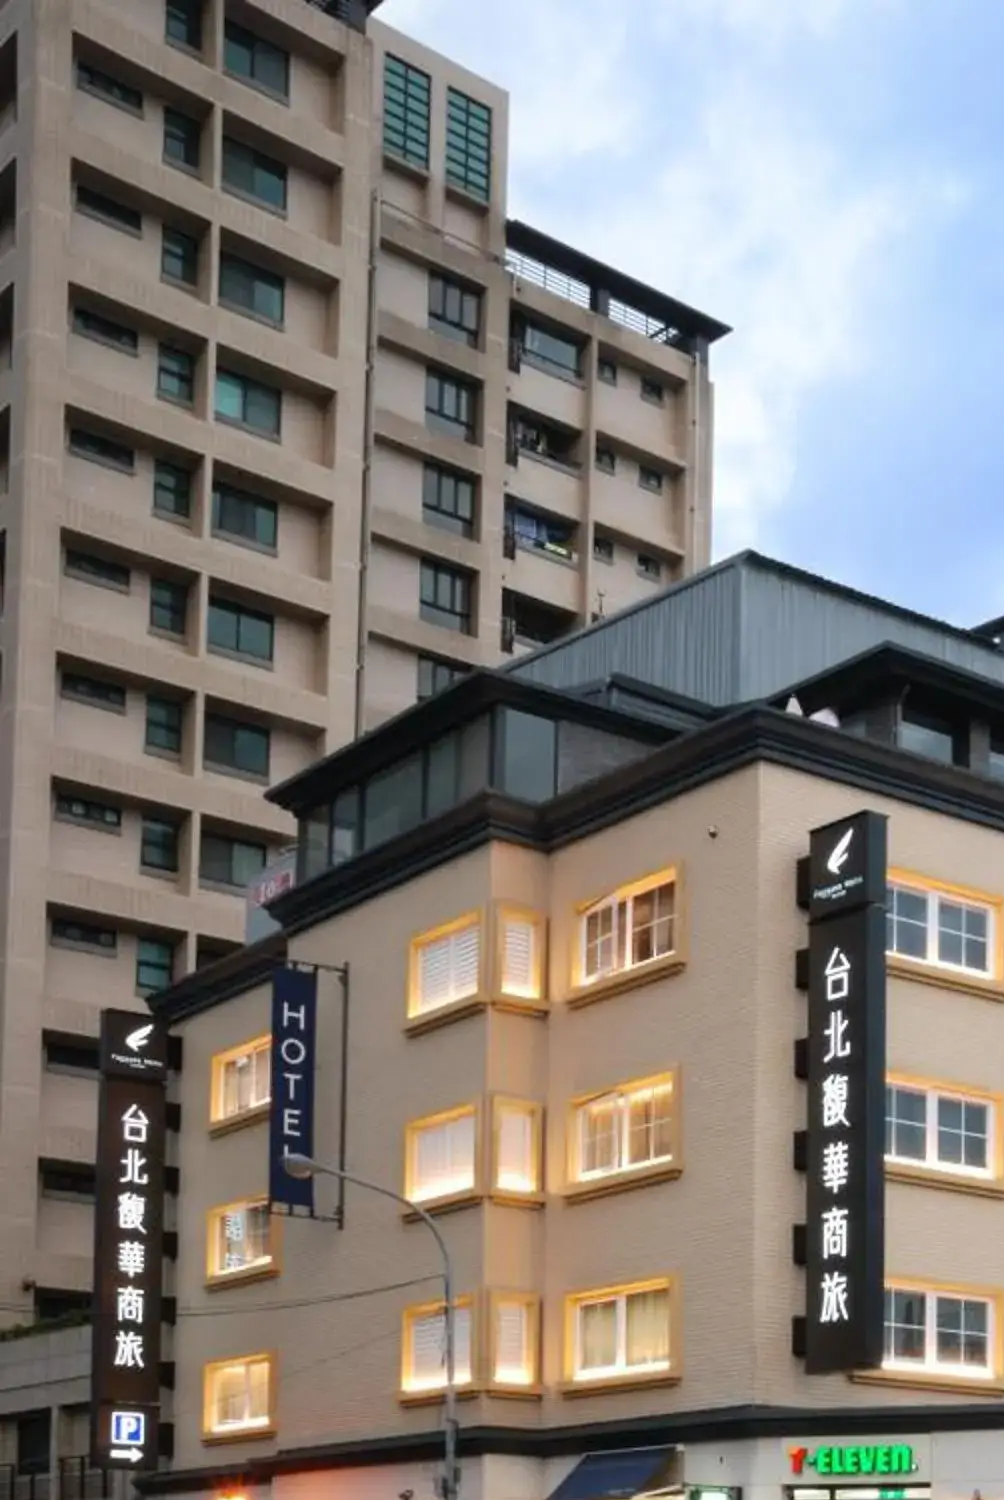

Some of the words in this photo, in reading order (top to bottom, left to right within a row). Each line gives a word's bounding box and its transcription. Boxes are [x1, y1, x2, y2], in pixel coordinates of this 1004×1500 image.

[114, 1103, 150, 1369] 台北馥華商旅
[820, 946, 851, 1323] 台北馥華商旅
